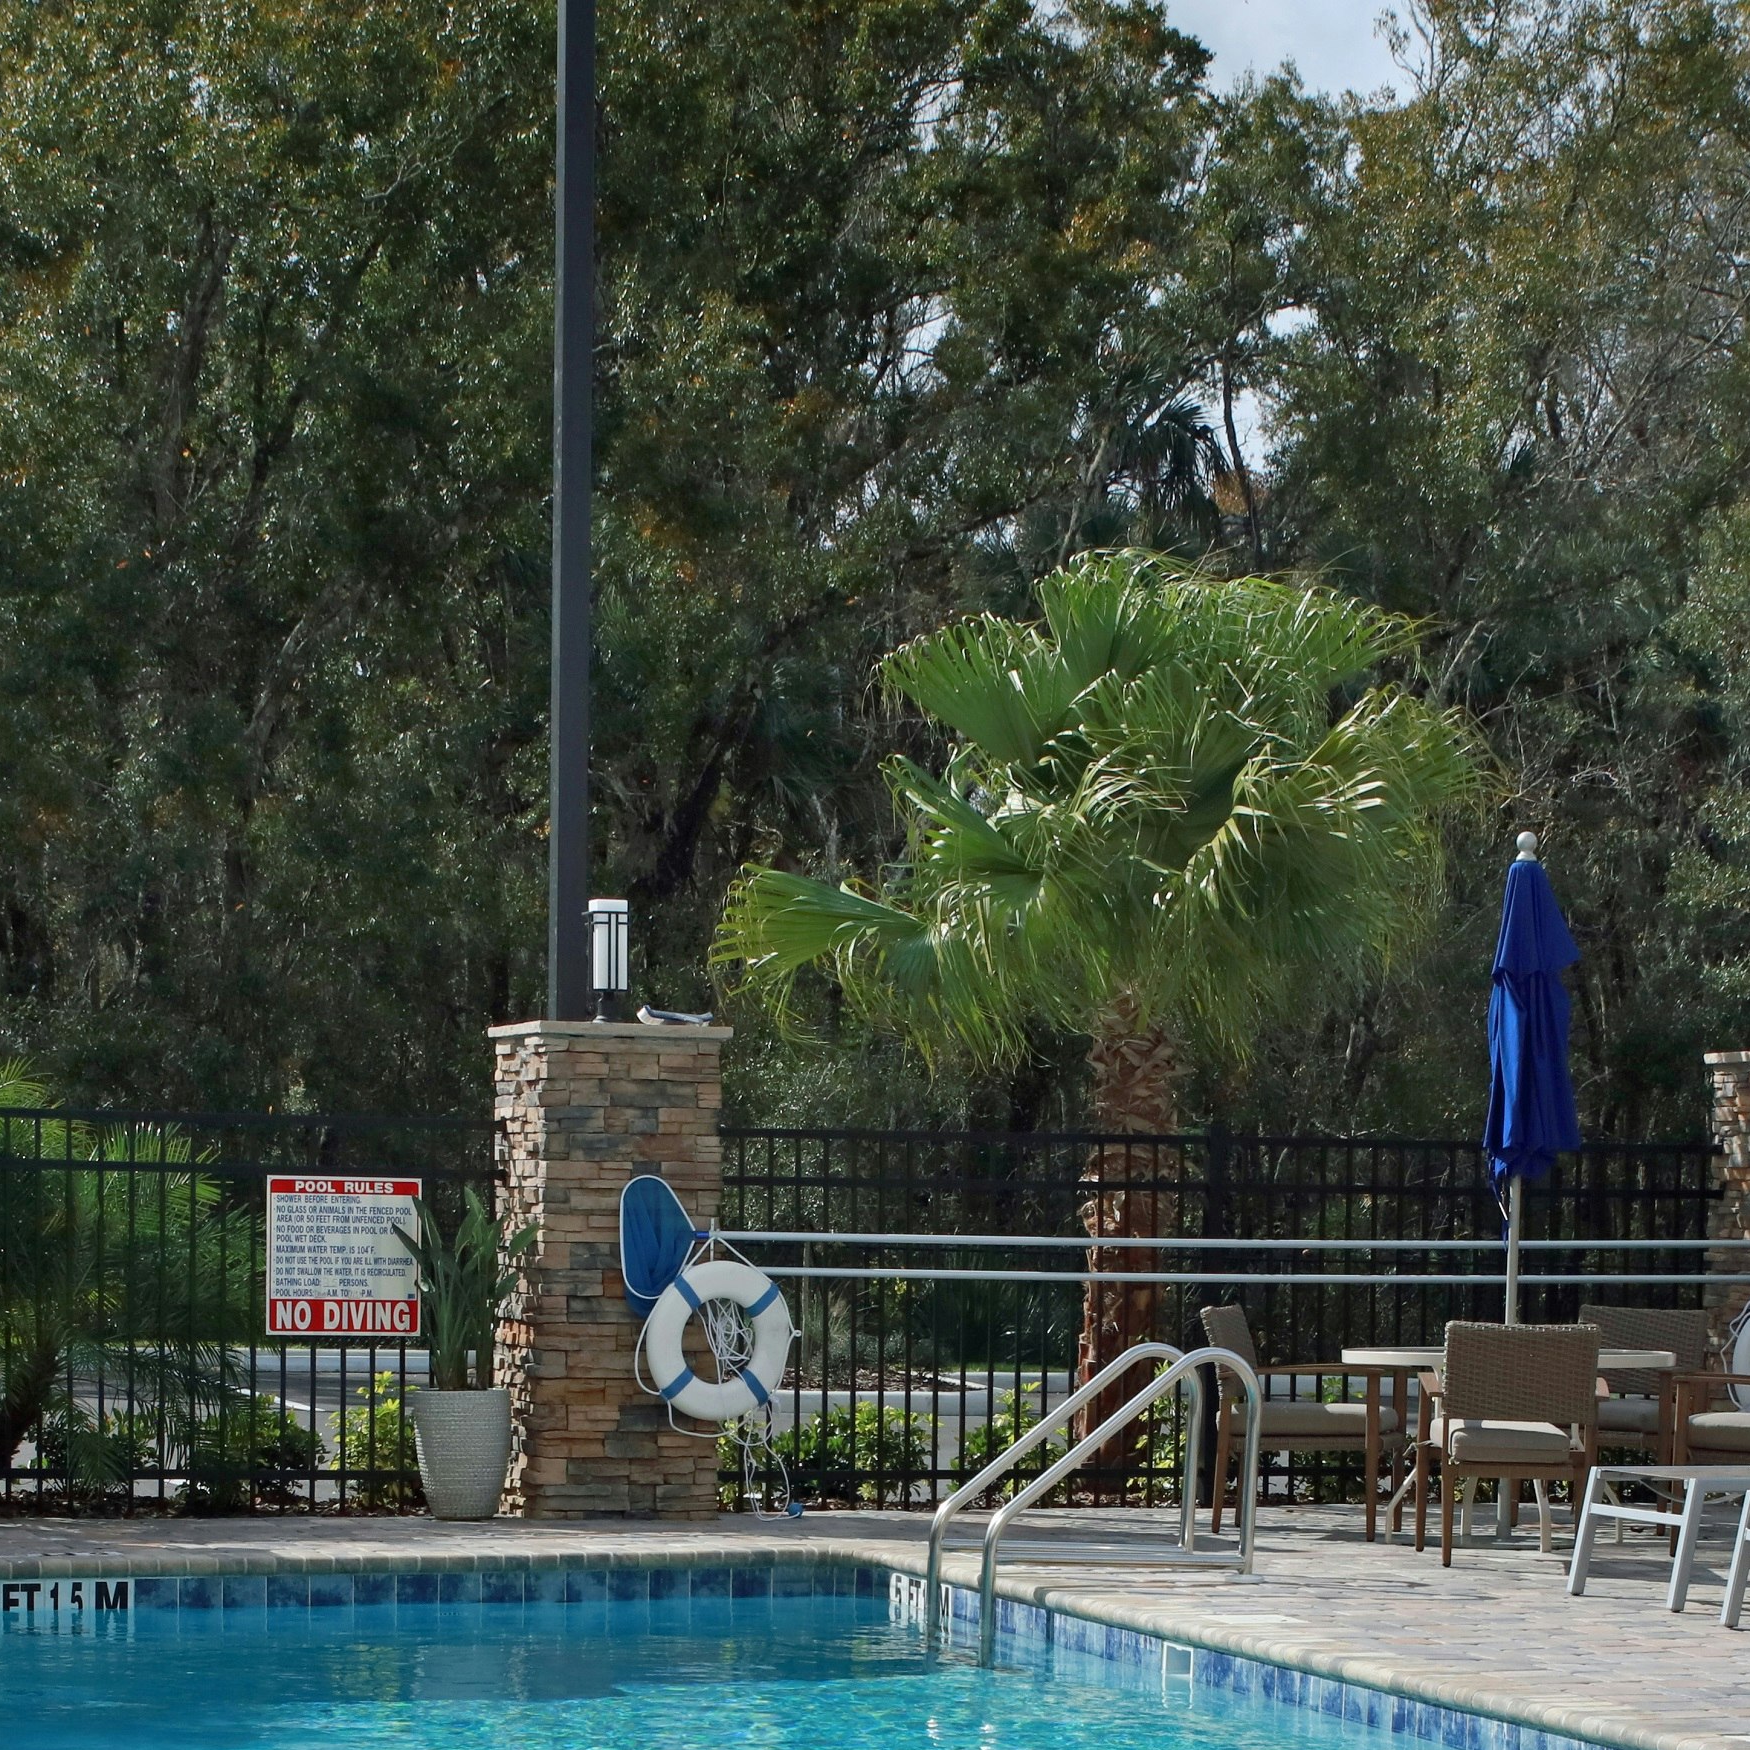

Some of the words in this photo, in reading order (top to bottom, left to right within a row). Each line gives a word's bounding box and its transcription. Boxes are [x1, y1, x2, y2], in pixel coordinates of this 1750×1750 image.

[295, 1181, 336, 1192] POOL
[344, 1182, 394, 1194] RULES
[276, 1195, 302, 1203] SHOWER
[304, 1195, 329, 1203] BEFORE
[331, 1196, 362, 1204] ENTERING.
[276, 1205, 286, 1213] NO
[287, 1206, 307, 1214] GLASS
[308, 1206, 318, 1214] OR
[318, 1206, 346, 1214] ANIMALS
[347, 1207, 355, 1215] IN
[356, 1207, 368, 1215] THE
[369, 1207, 394, 1215] FENCED
[395, 1207, 412, 1215] POOL
[276, 1215, 293, 1223] AREA
[294, 1215, 305, 1224] (OR
[306, 1215, 315, 1223] 50
[316, 1215, 331, 1223] FEET
[332, 1216, 350, 1224] FROM
[351, 1216, 385, 1224] UNFENCED
[276, 1225, 286, 1233] NO
[287, 1225, 304, 1233] FOOD
[316, 1226, 351, 1234] BEVERAGES
[352, 1226, 360, 1234] IN
[361, 1227, 378, 1235] POOL
[379, 1227, 389, 1235] OR
[294, 1235, 308, 1243] WET
[276, 1245, 306, 1253] MAXIMUM
[329, 1246, 348, 1254] TEMP.
[349, 1246, 356, 1254] IS
[275, 1256, 284, 1264] DO
[285, 1257, 296, 1265] NOT
[297, 1257, 308, 1265] USE
[308, 1257, 319, 1265] THE
[319, 1257, 334, 1265] POOL
[334, 1257, 340, 1265] IF
[341, 1257, 352, 1265] YOU
[353, 1257, 364, 1265] ARE
[364, 1257, 372, 1265] ILL
[373, 1257, 387, 1265] WITH
[275, 1267, 284, 1275] DO
[285, 1267, 296, 1275] NOT
[323, 1268, 334, 1276] THE
[354, 1268, 360, 1276] IT
[275, 1278, 303, 1286] BATHING
[304, 1278, 322, 1286] LOAD:
[339, 1279, 369, 1287] PERSONS.
[275, 1289, 292, 1297] POOL
[341, 1289, 349, 1297] TO
[276, 1301, 311, 1330] NO
[323, 1301, 411, 1331] DIVING
[2, 1583, 41, 1611] FT
[95, 1581, 128, 1610] M
[909, 1579, 921, 1607] FT
